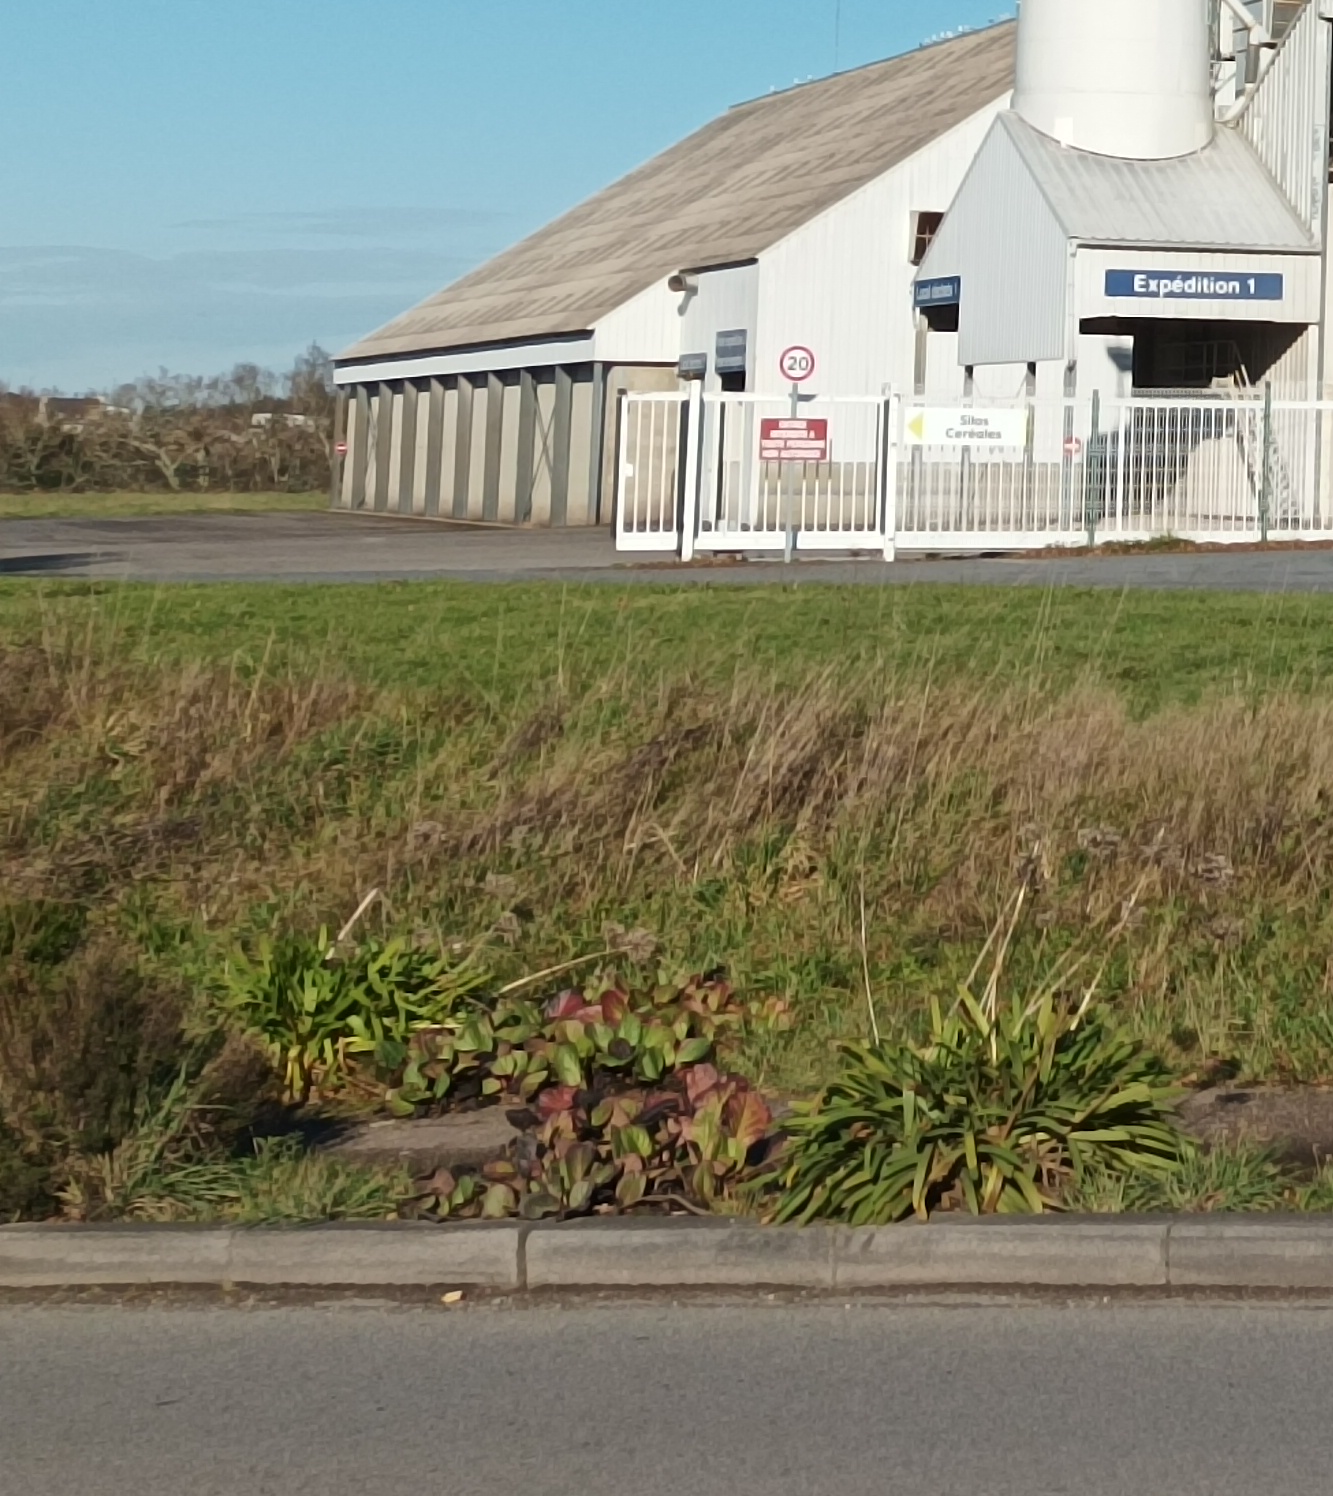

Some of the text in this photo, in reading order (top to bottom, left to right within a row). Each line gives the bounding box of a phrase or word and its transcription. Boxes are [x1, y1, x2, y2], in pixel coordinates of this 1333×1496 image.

[1133, 274, 1255, 298] Expédition 1
[787, 356, 809, 371] 20
[960, 414, 989, 426] Silos
